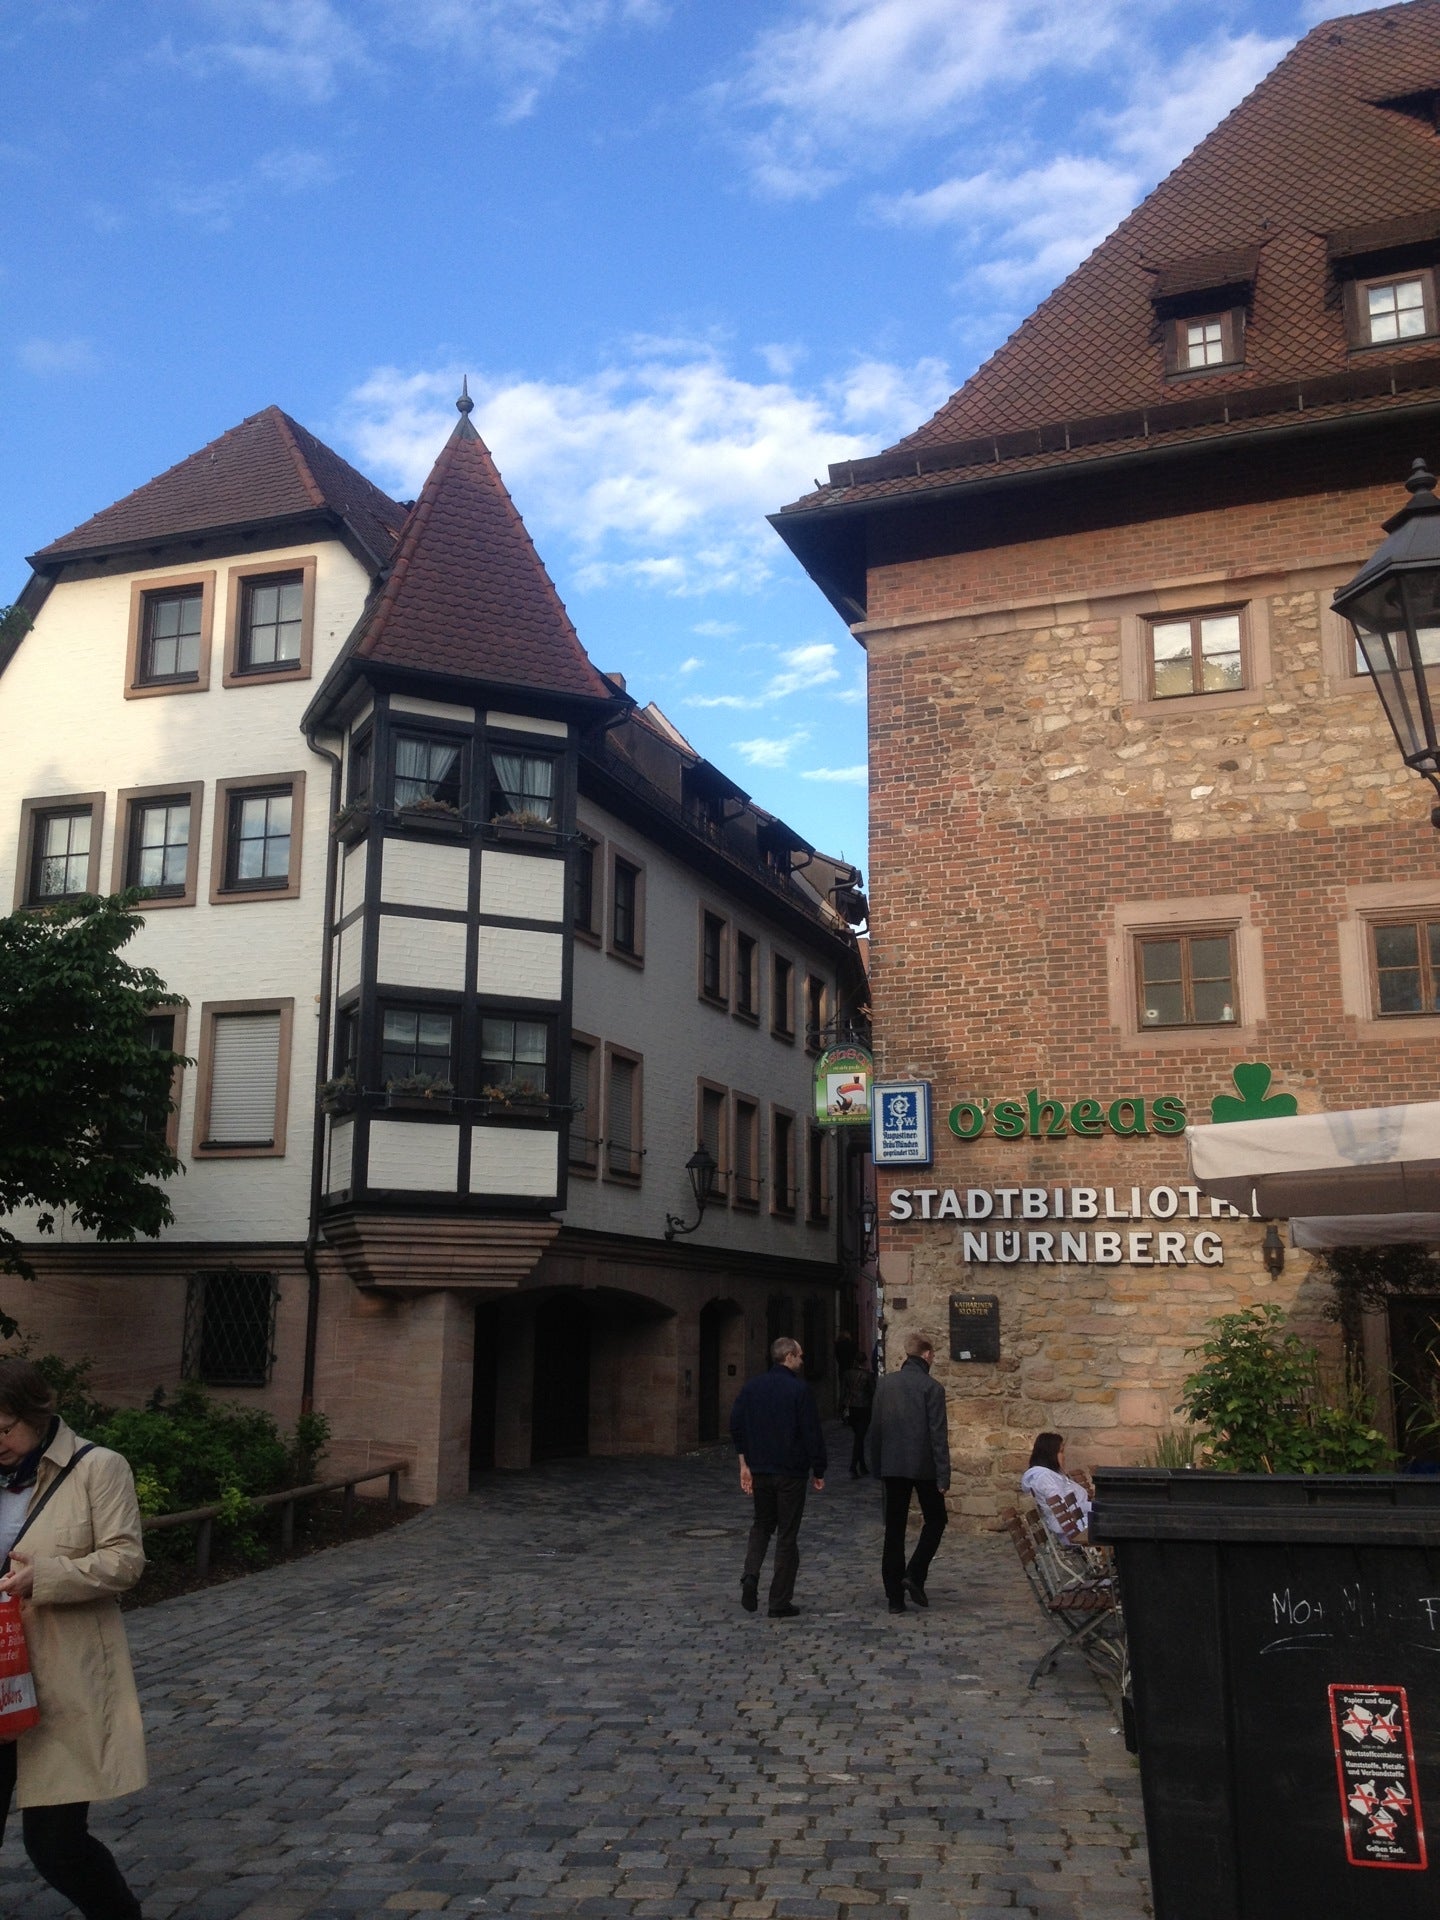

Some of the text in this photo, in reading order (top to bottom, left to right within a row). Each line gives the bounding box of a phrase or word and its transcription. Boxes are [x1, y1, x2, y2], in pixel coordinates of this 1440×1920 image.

[948, 1087, 1188, 1138] o'sheas
[963, 1230, 1224, 1265] NÜRNBERG
[1343, 1696, 1363, 1704] Papier
[1378, 1697, 1392, 1705] Glas
[1361, 1769, 1405, 1777] Verbundstoffe
[1366, 1844, 1388, 1852] Gelben
